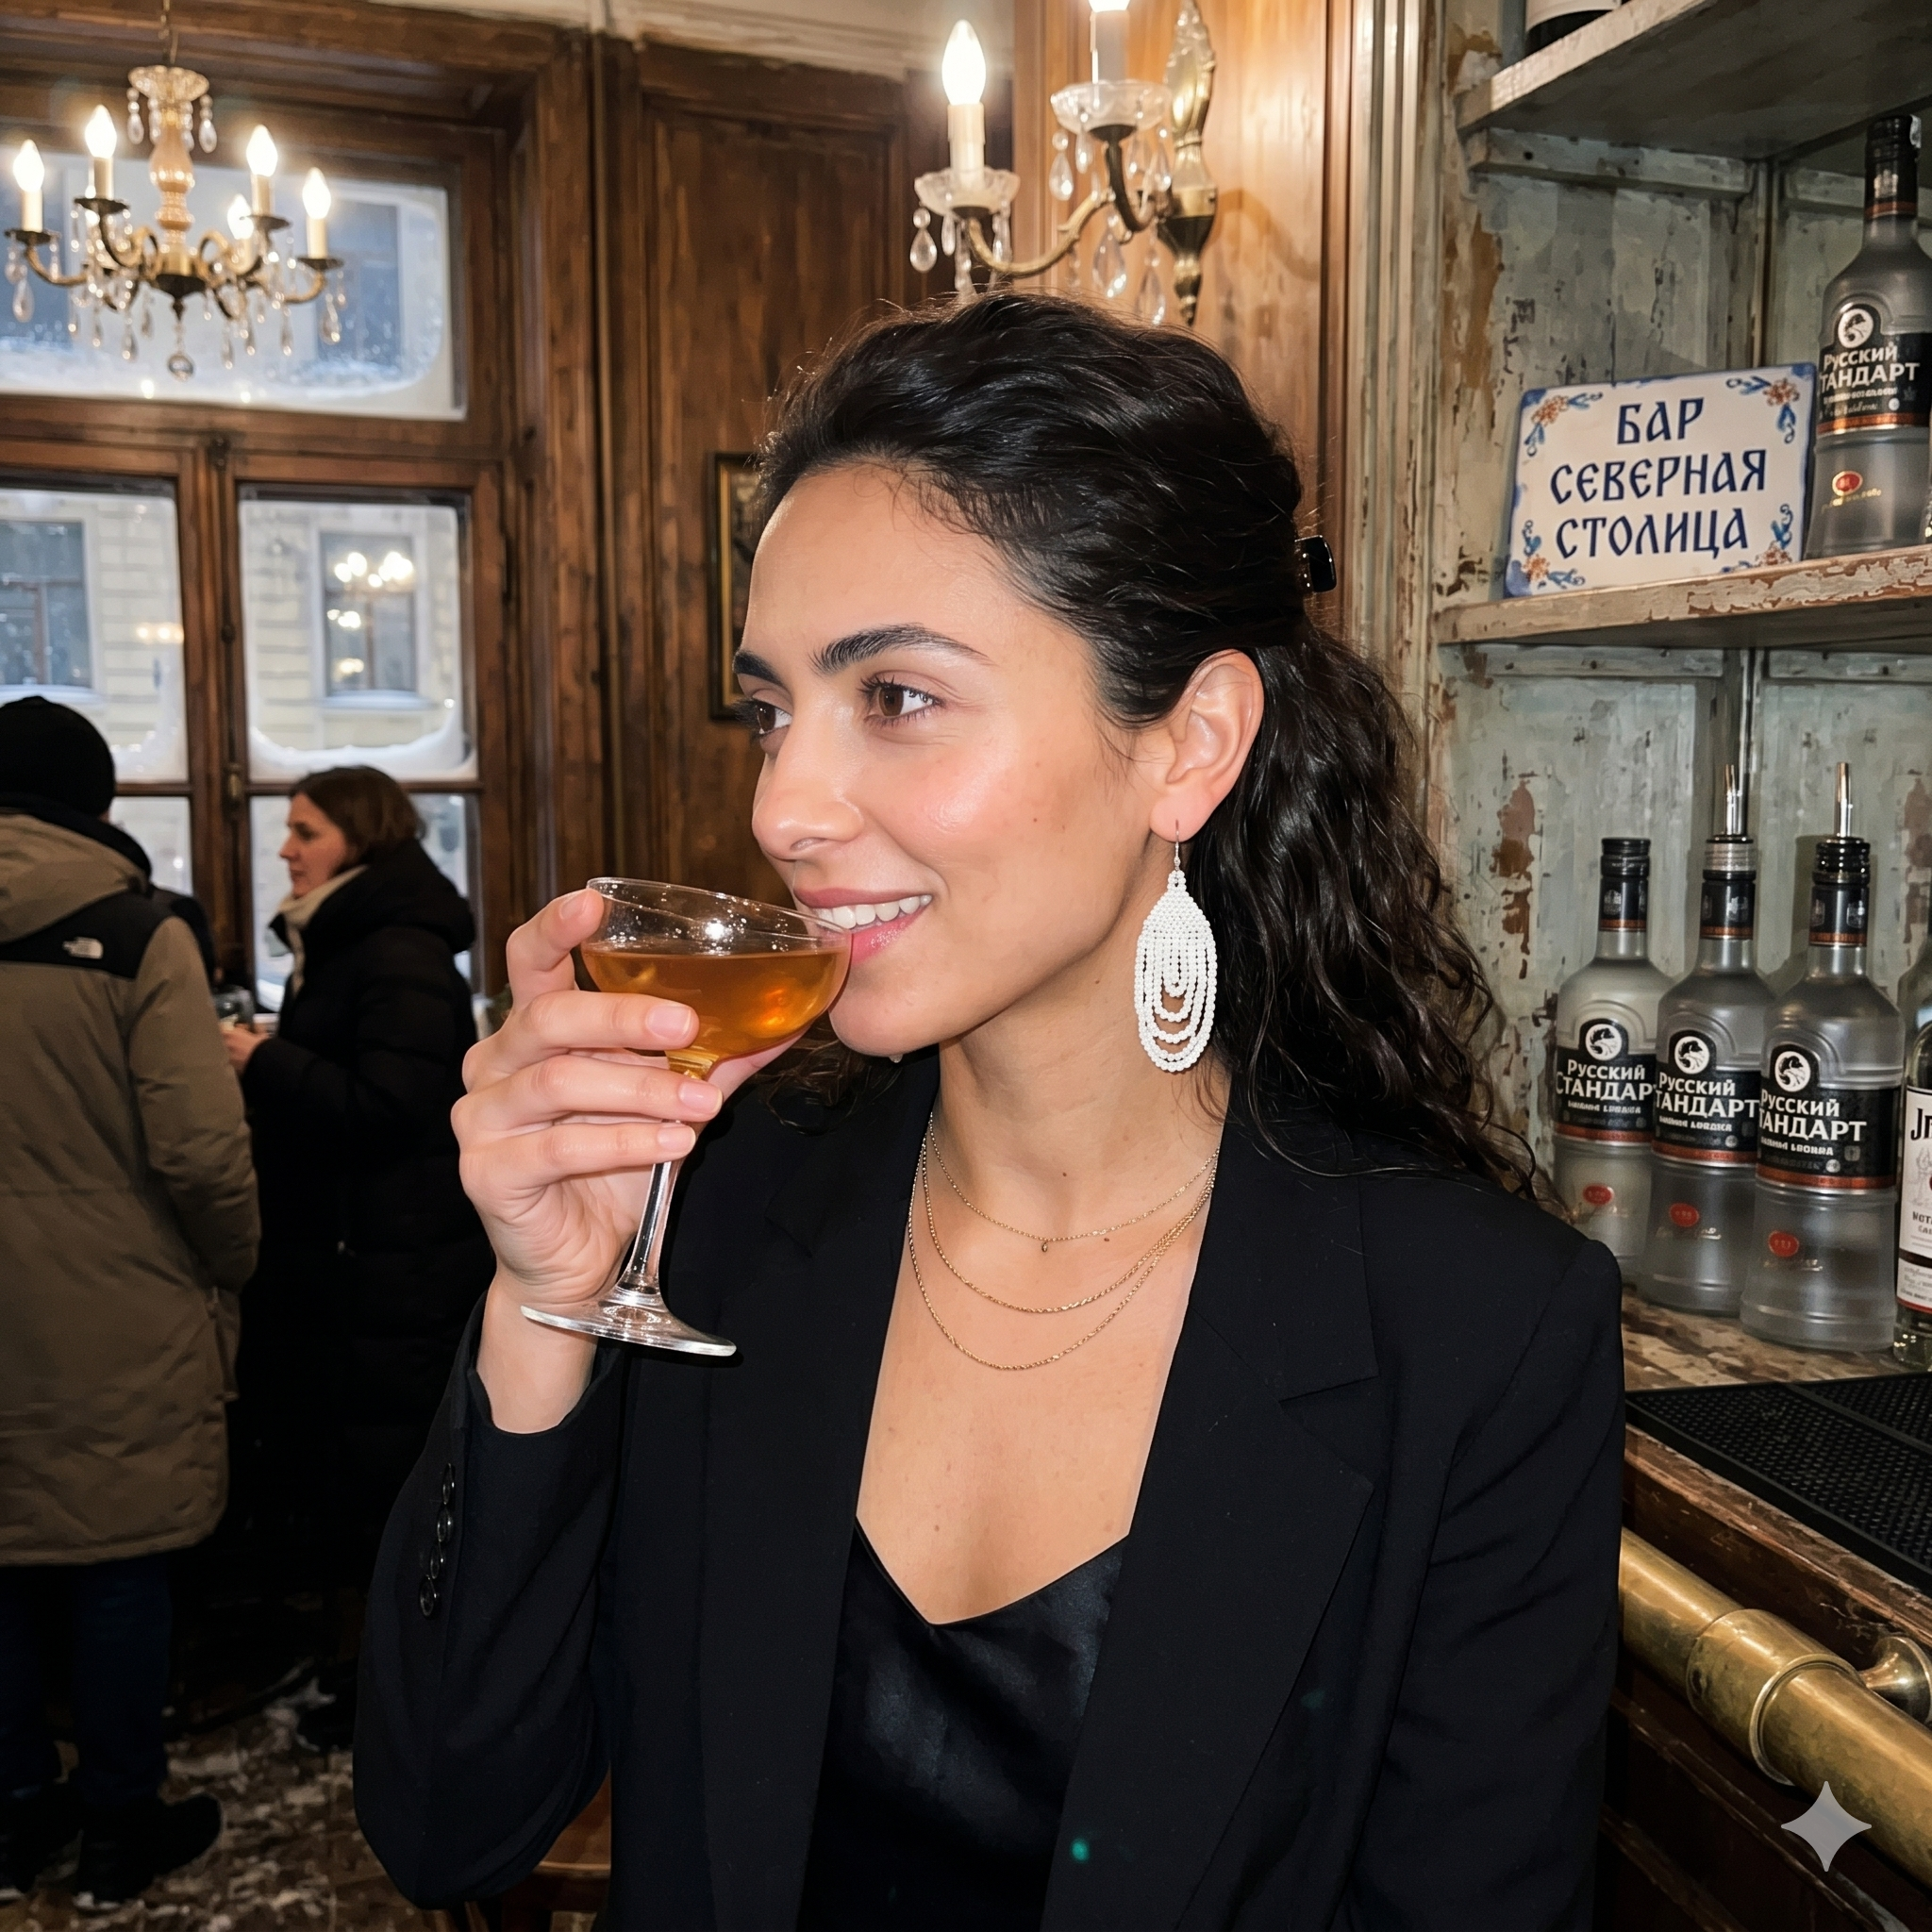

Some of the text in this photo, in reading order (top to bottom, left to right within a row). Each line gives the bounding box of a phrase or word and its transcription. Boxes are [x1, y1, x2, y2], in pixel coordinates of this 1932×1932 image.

[1616, 397, 1705, 446] БАР
[1550, 449, 1767, 505] СЕВЕРНАЯ
[1555, 508, 1748, 559] СТОЛИЦА
[1556, 1071, 1657, 1103] СТАНДАР
